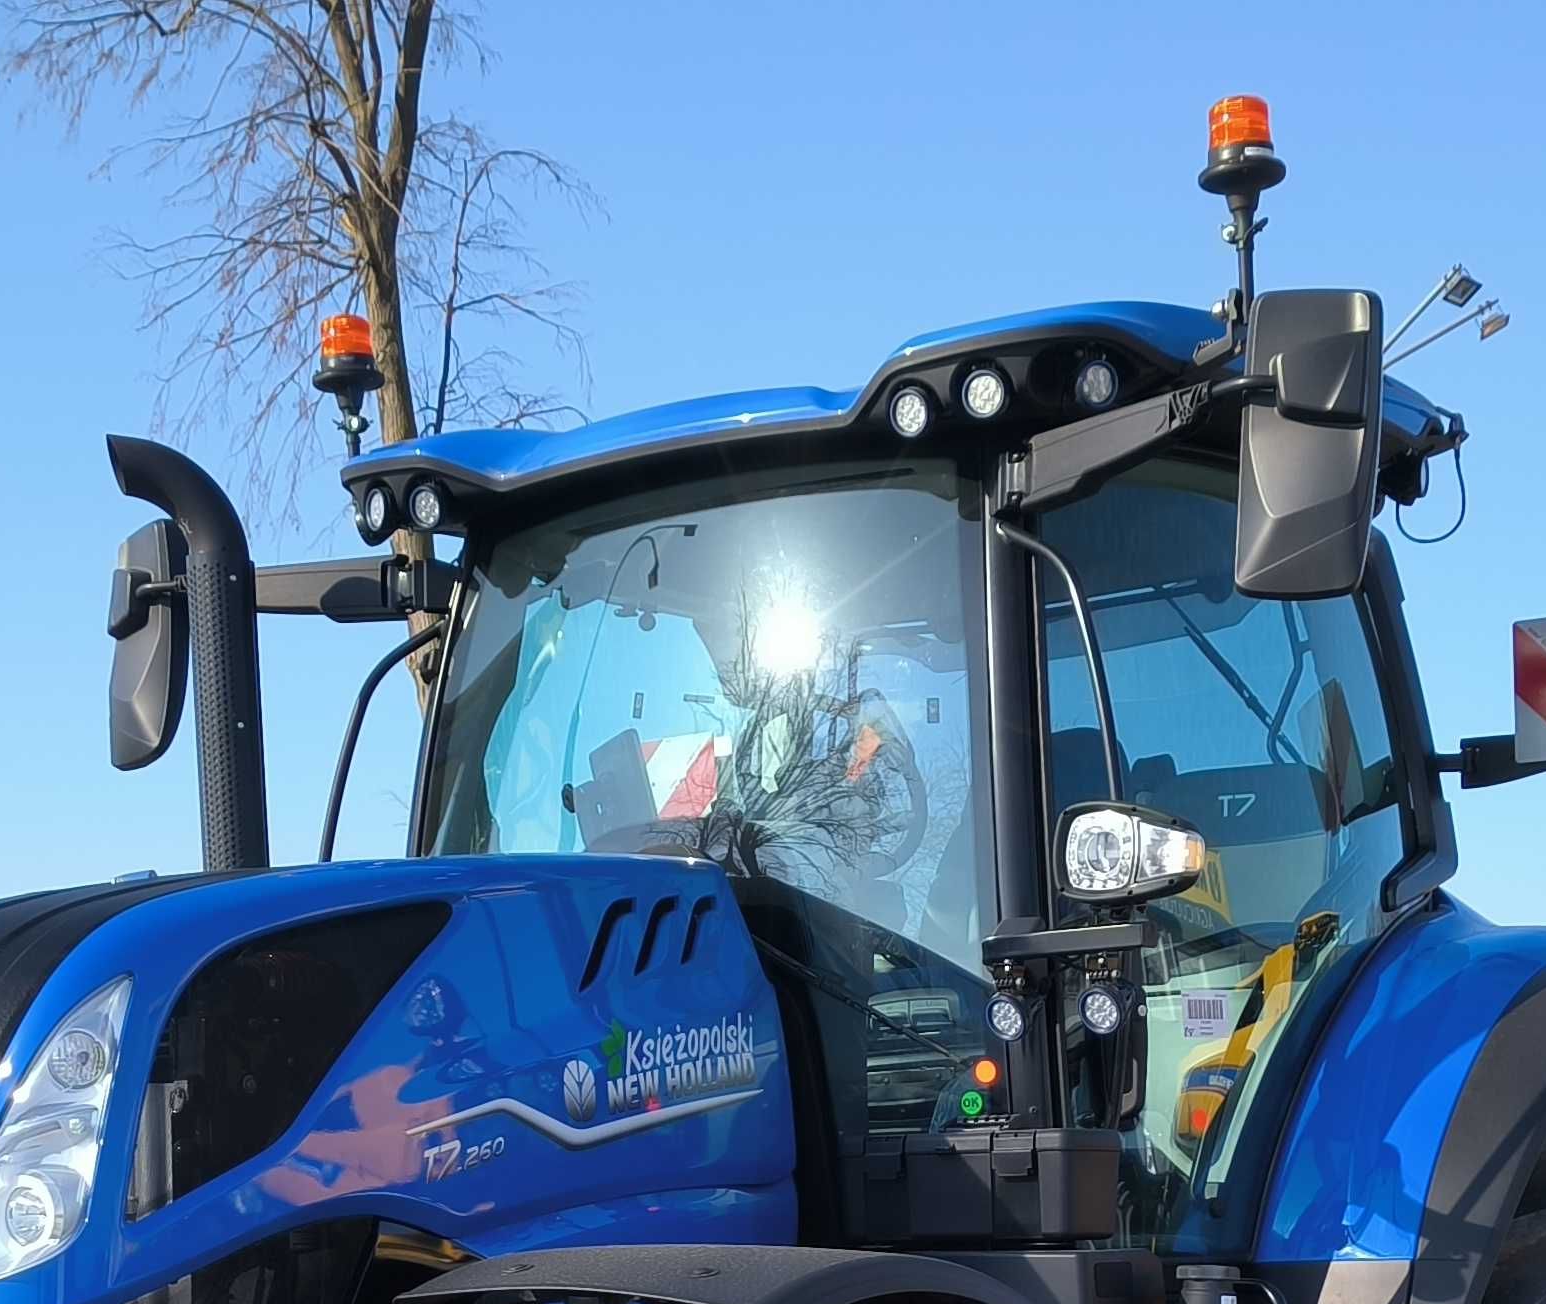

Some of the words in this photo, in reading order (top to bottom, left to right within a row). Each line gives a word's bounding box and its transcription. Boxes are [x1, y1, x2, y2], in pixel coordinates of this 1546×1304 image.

[1218, 793, 1256, 817] T7
[625, 1012, 754, 1075] Księżopolski
[607, 1069, 660, 1114] NEW
[665, 1053, 757, 1099] HOLLAND
[962, 1096, 980, 1108] OK
